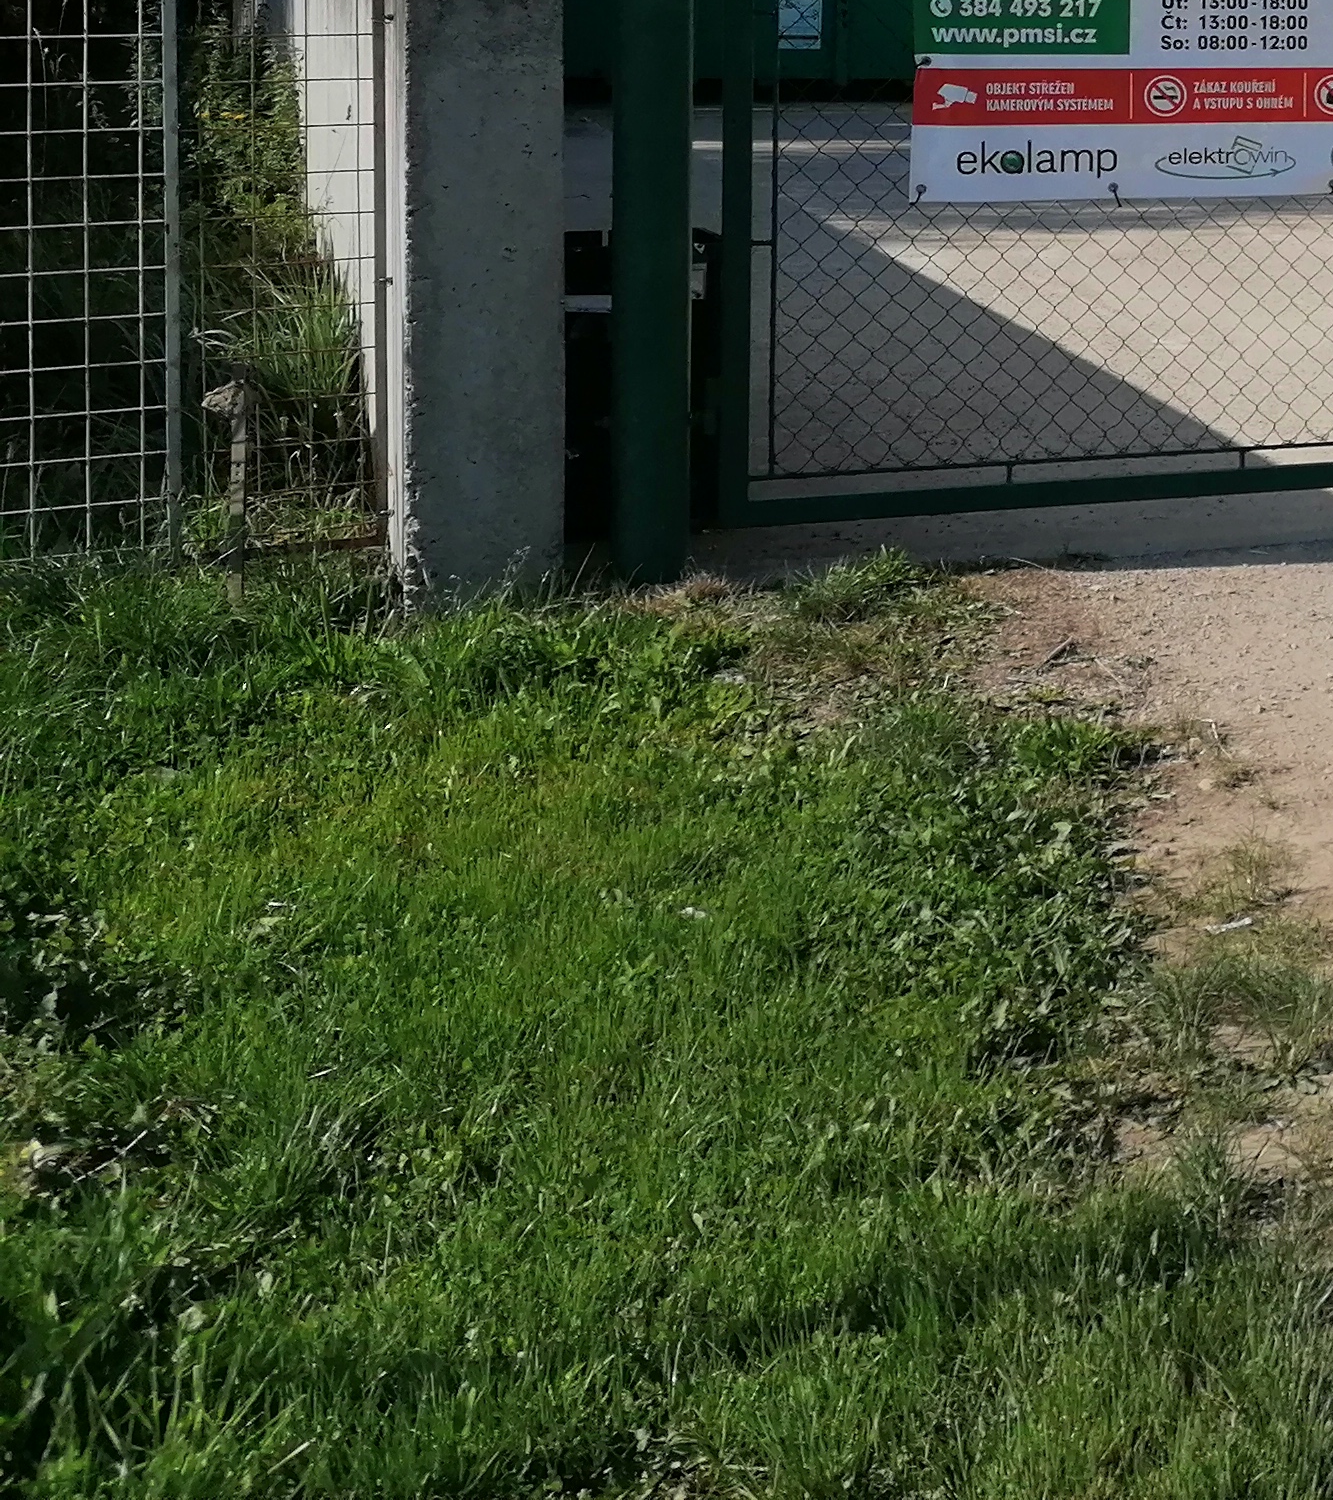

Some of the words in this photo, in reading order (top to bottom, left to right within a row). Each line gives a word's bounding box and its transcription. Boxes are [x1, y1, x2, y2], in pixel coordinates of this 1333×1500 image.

[1161, 10, 1187, 31] Čt:
[932, 23, 1097, 47] www.pmsi.cz
[1160, 35, 1190, 50] So:
[986, 82, 1026, 95] OBJEKT
[1029, 79, 1074, 95] STŘEŽEN
[1193, 79, 1226, 93] ZÁKAZ
[1229, 78, 1275, 93] KOUŘENÍ
[986, 96, 1054, 112] KAMEROVÝM
[1057, 96, 1113, 111] SYSTÉMEM
[1193, 98, 1200, 109] A
[1204, 97, 1244, 110] VSTUPU
[1247, 97, 1253, 109] S
[957, 140, 1117, 178] ekolamp
